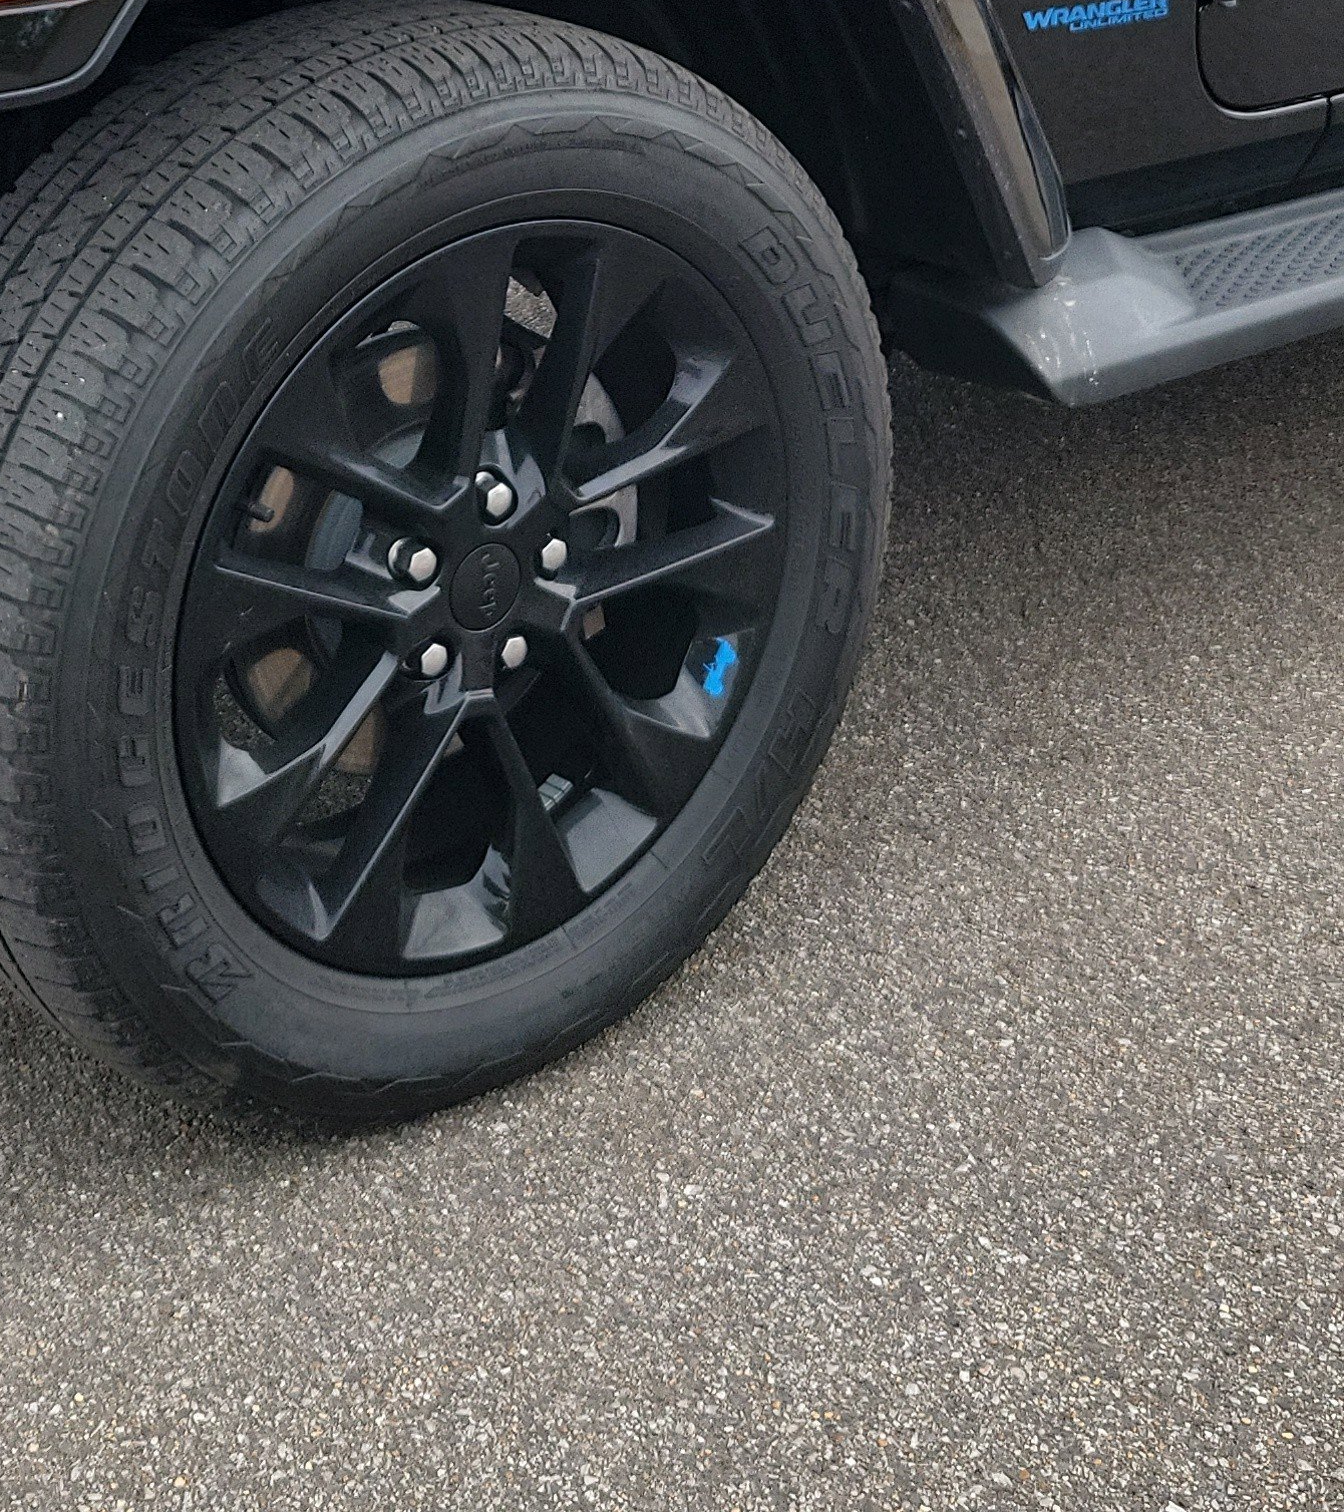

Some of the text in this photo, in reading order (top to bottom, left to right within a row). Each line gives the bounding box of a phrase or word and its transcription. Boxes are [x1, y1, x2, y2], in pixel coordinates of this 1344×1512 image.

[1069, 7, 1169, 33] UNLIMITED
[738, 226, 860, 635] DUELER
[117, 317, 283, 1005] BRIDGESTONE
